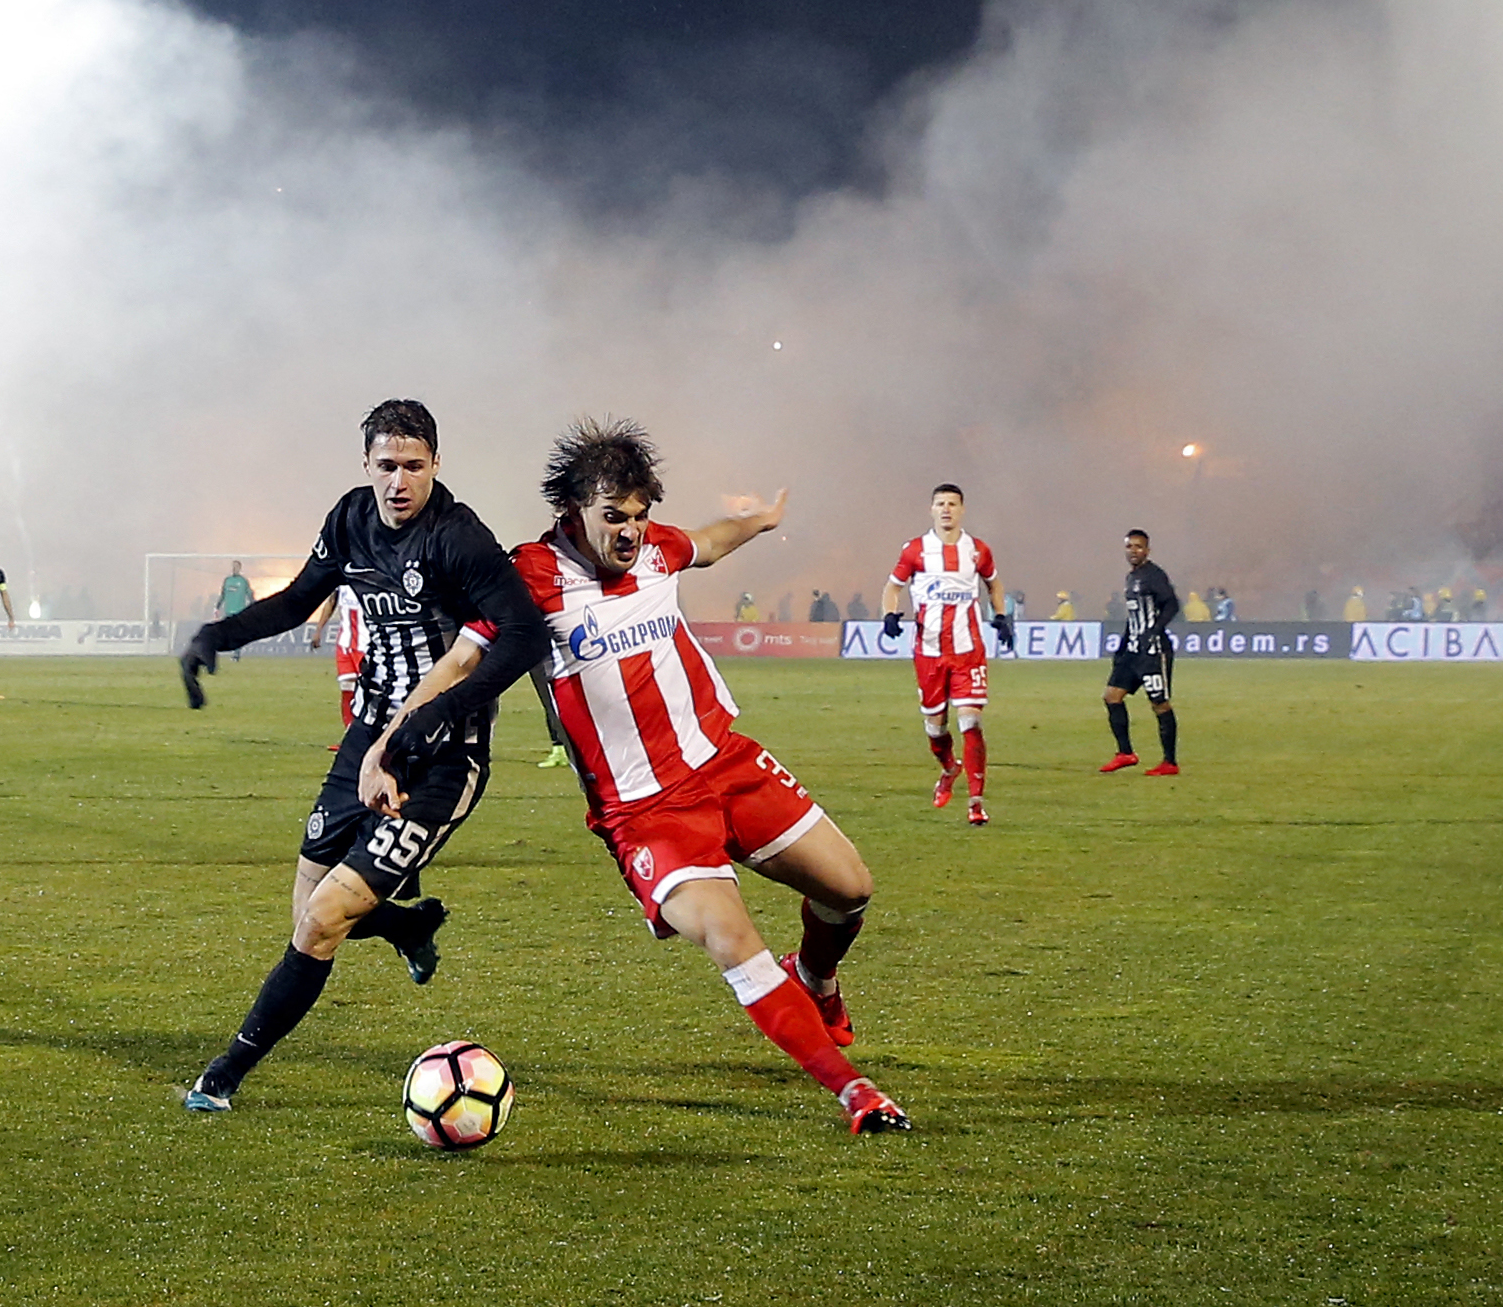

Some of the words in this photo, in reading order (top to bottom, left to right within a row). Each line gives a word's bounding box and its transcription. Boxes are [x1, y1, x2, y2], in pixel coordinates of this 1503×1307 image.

[362, 592, 422, 615] mts
[607, 615, 676, 653] GAZPROM
[763, 634, 793, 645] mts
[1143, 675, 1164, 692] 20
[366, 816, 429, 868] 55
